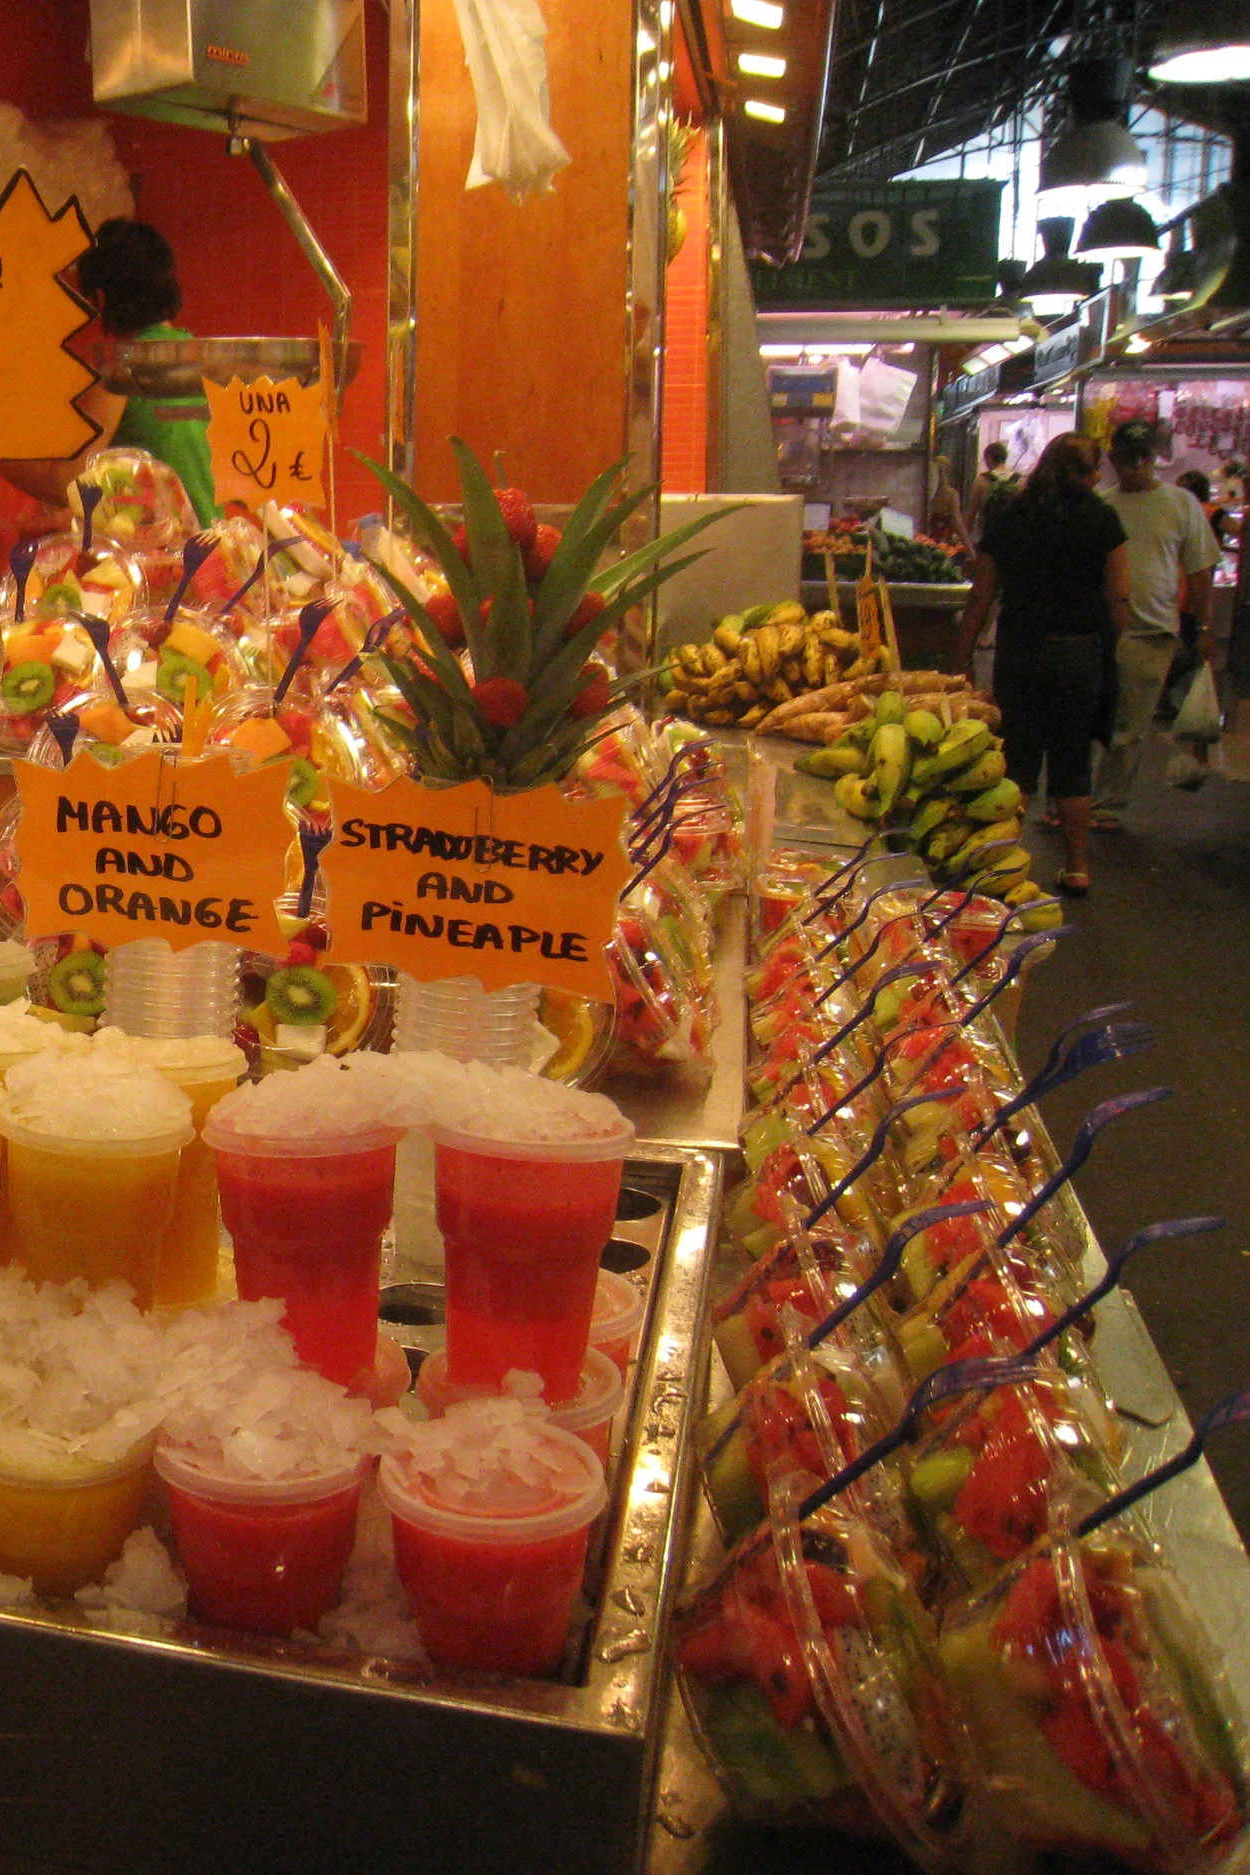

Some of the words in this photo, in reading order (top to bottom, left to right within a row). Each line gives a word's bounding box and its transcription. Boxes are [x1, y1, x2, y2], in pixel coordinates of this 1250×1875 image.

[239, 391, 291, 414] UNA
[231, 418, 277, 489] 2
[289, 450, 312, 481] €
[56, 796, 223, 840] MANGO
[95, 847, 194, 883] AND
[340, 818, 604, 876] STRAWBERRY
[58, 883, 259, 933] ORANGE
[417, 871, 515, 905] AND
